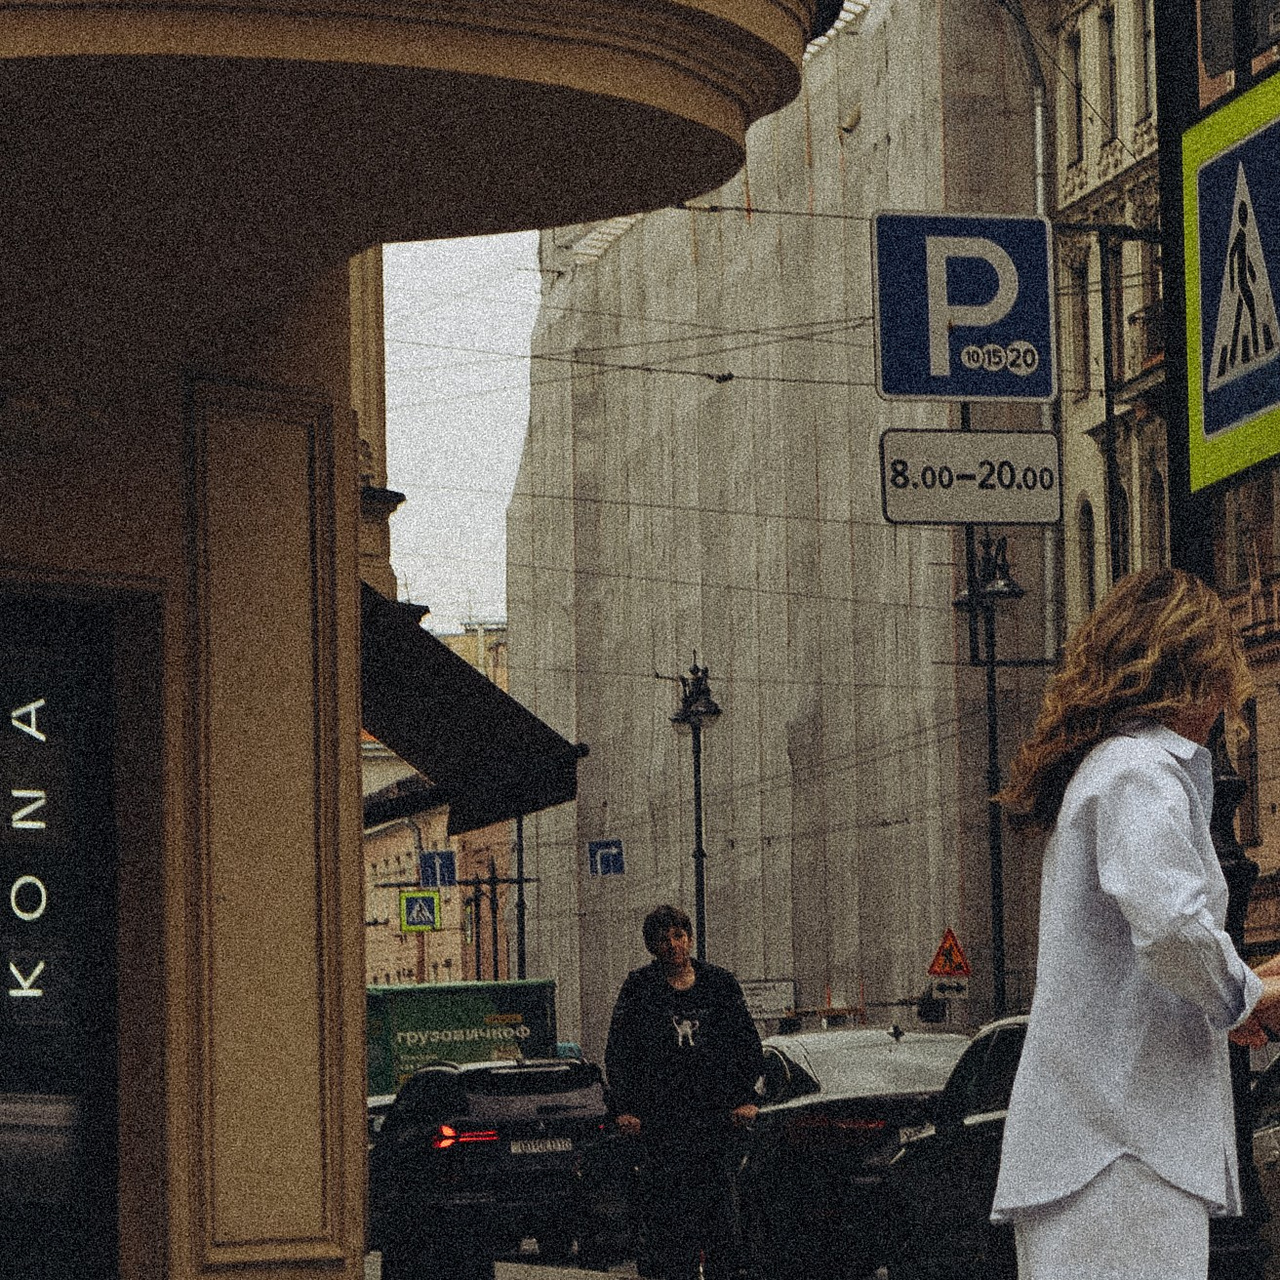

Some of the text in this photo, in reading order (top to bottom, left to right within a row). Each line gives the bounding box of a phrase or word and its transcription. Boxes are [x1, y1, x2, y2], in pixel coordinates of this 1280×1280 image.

[926, 236, 1019, 377] P
[1009, 347, 1035, 369] 20
[8, 698, 46, 997] KONA
